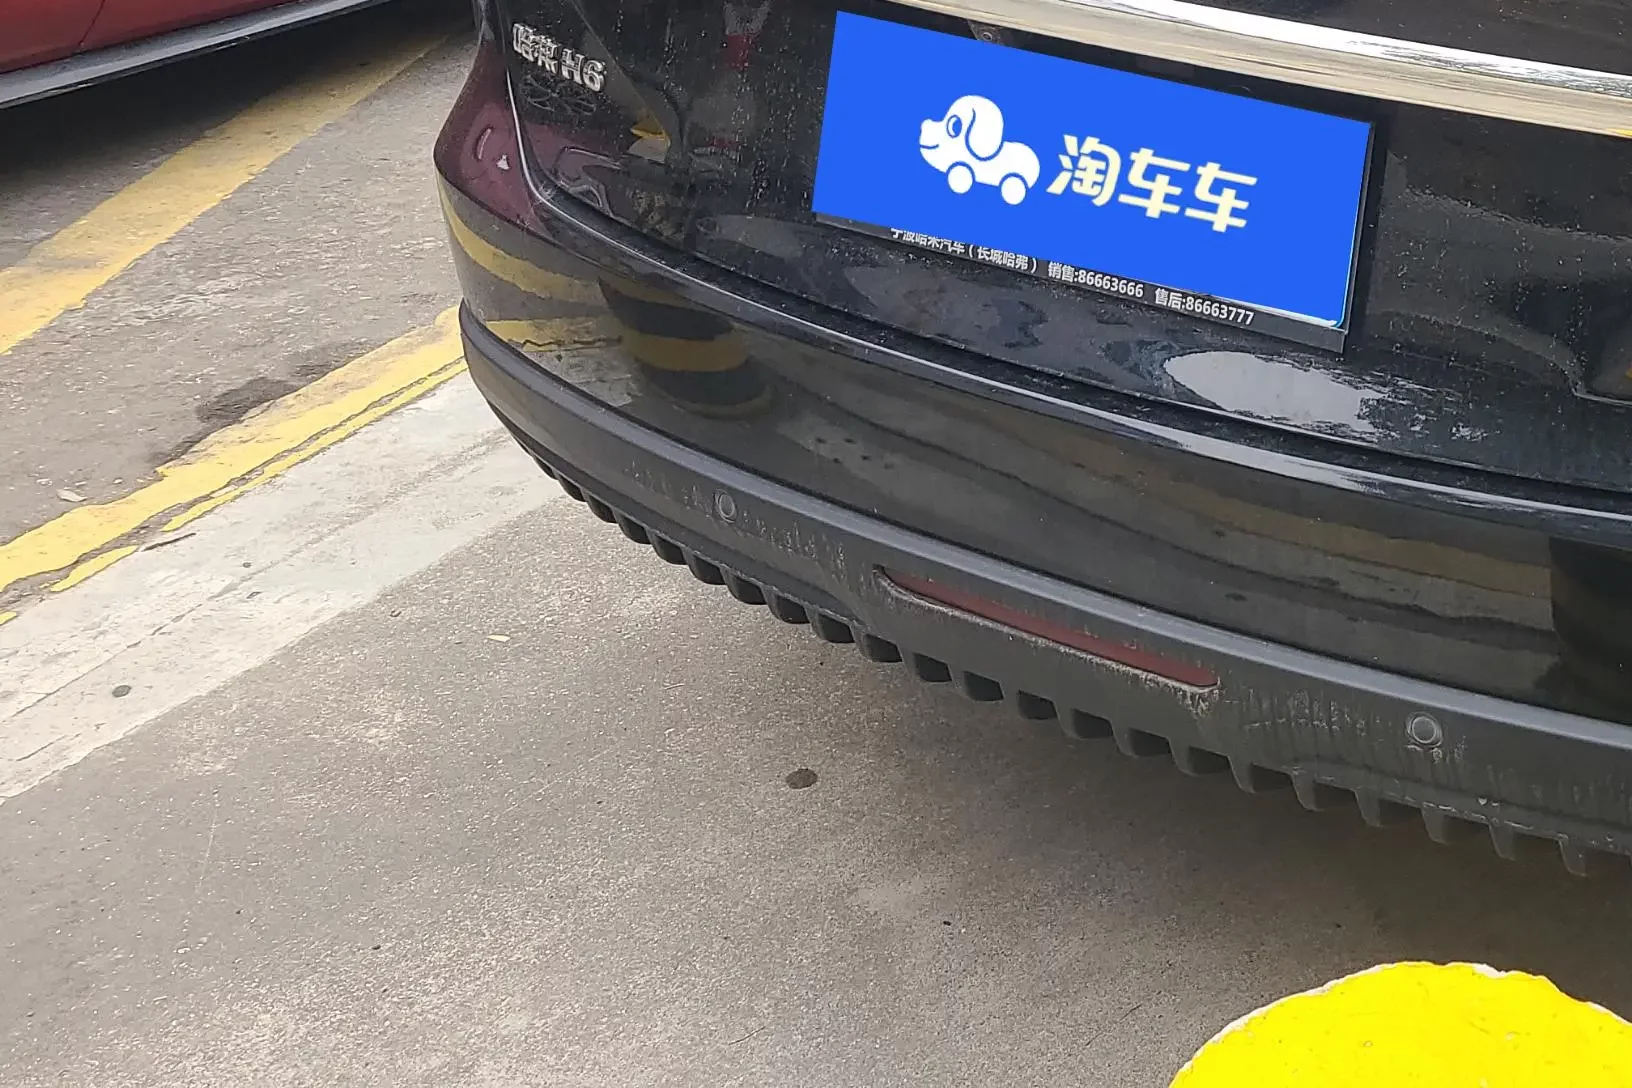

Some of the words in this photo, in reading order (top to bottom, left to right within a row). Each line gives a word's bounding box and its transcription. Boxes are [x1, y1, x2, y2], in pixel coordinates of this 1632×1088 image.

[561, 48, 606, 92] H6
[1048, 261, 1144, 298] 销售:86663666
[1155, 288, 1254, 325] 售后:86663777
